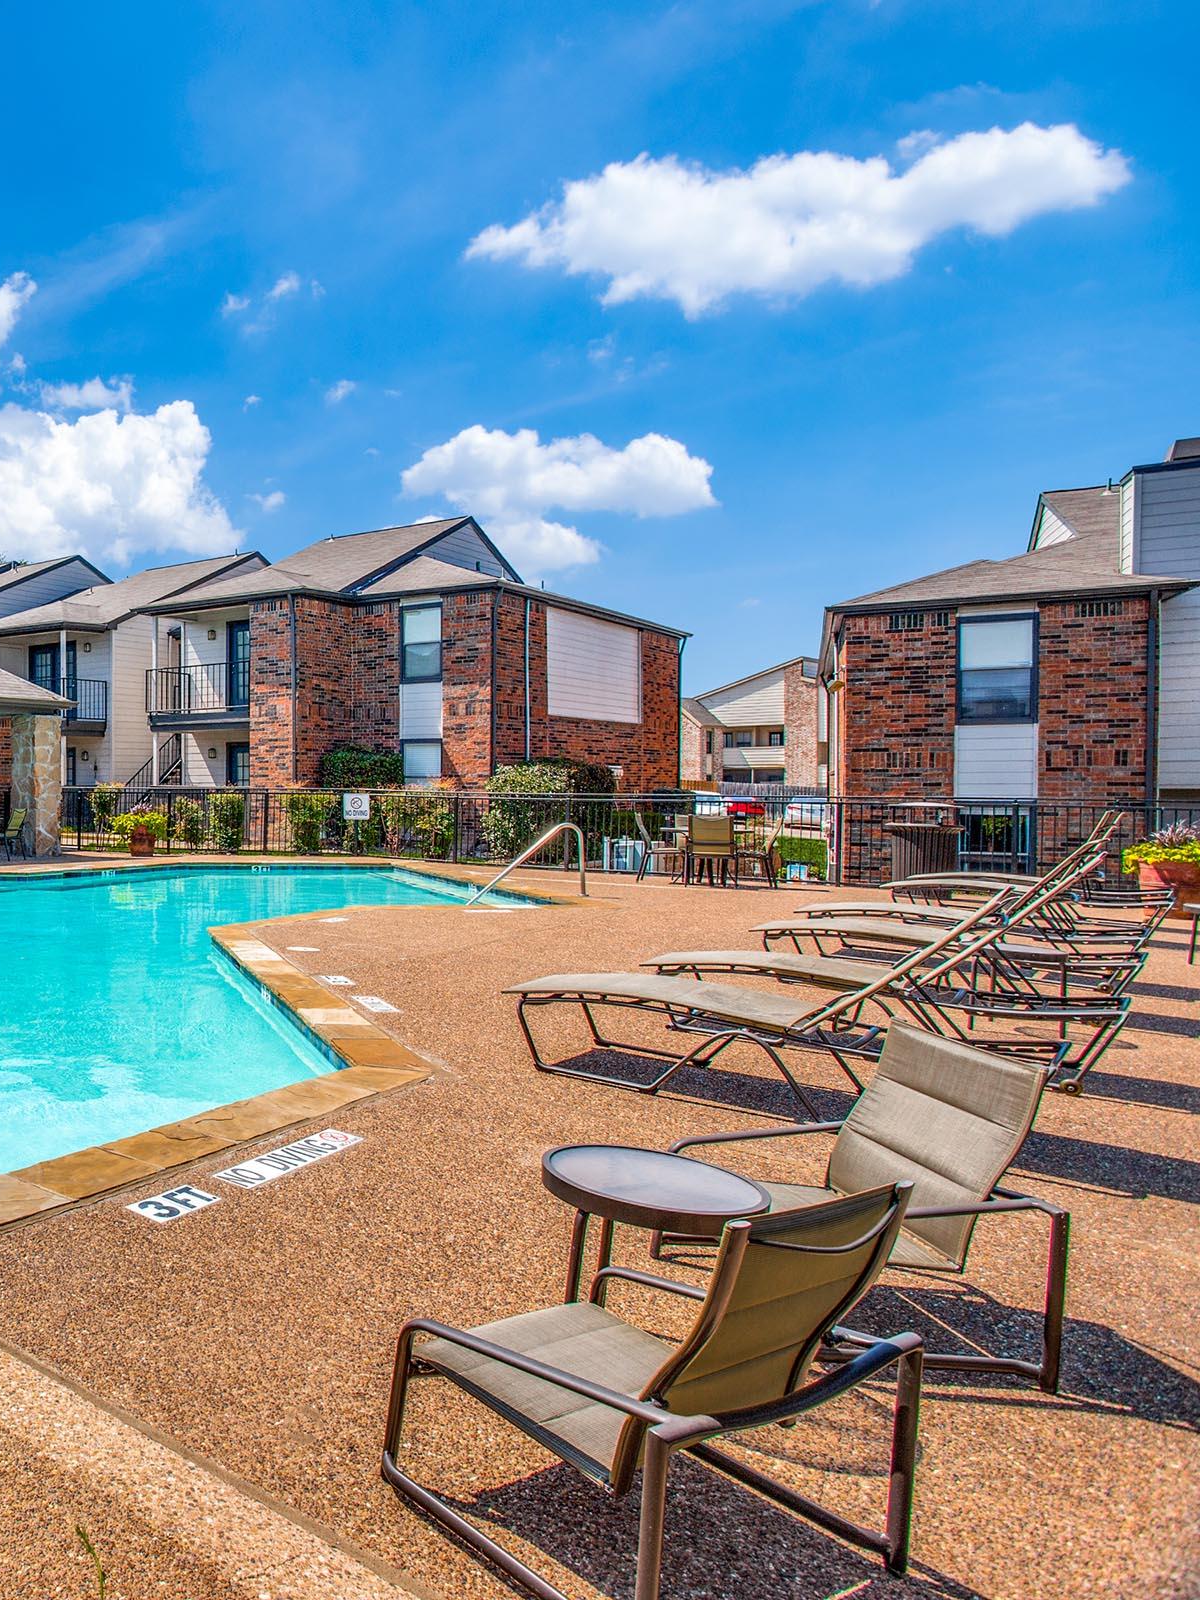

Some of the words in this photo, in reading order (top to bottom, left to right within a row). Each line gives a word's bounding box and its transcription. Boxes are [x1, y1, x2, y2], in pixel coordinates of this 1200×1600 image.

[217, 1167, 266, 1188] NO
[255, 1138, 338, 1172] DIVING
[137, 1189, 181, 1218] 3
